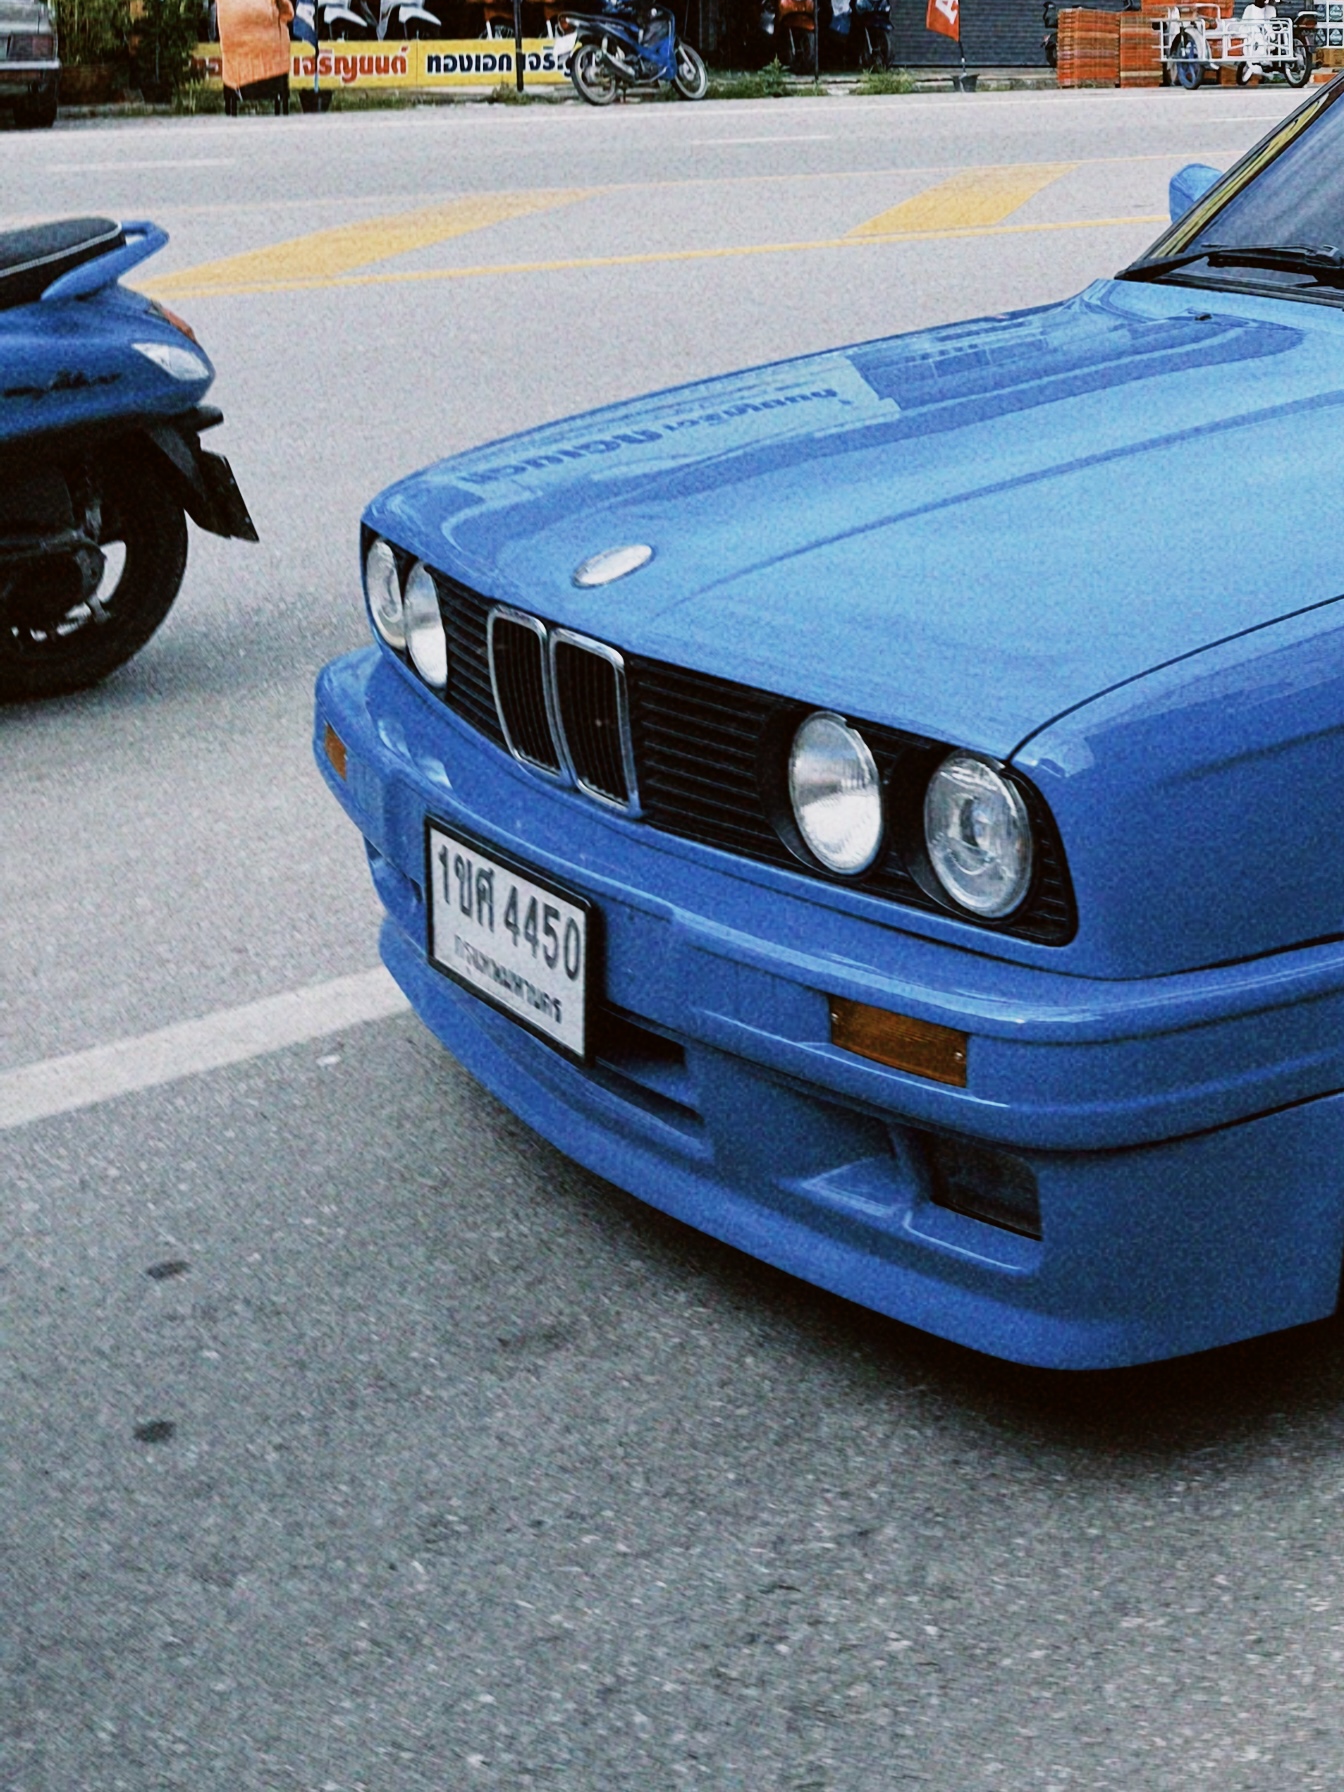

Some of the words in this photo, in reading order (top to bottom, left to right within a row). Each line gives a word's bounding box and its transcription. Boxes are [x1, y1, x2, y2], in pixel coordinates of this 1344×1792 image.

[293, 46, 409, 83] เจริญยนต์
[426, 53, 511, 73] ทองเอก
[503, 884, 581, 981] 4450
